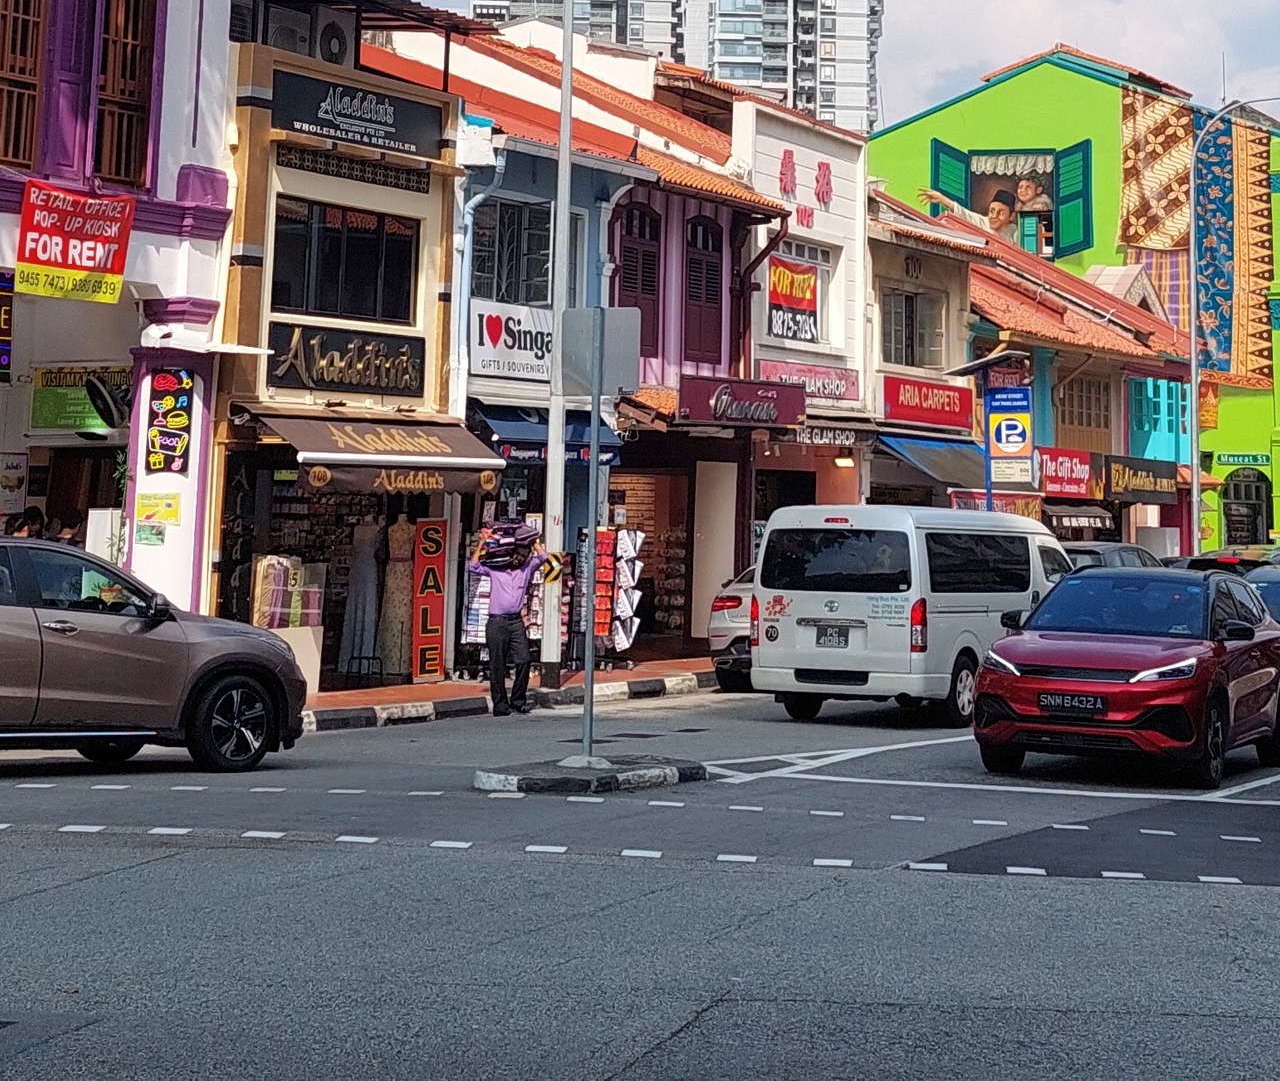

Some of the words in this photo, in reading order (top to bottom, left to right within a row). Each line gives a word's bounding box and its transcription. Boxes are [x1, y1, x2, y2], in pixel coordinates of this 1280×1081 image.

[318, 85, 395, 124] Aladdin's
[293, 121, 361, 141] WHOLESALER
[362, 134, 370, 143] &
[371, 137, 417, 153] RETAILER
[30, 187, 74, 211] RETAIL
[84, 199, 124, 217] OFFICE
[64, 215, 82, 232] UP
[83, 219, 121, 237] KIOSK
[25, 231, 62, 263] FOR
[68, 239, 118, 269] RENT
[19, 270, 40, 288] 9455
[771, 265, 792, 295] FOR
[477, 314, 485, 346] I
[272, 327, 420, 390] Aladdin's
[481, 359, 501, 370] GIFTS
[42, 373, 64, 387] VISIT
[824, 379, 846, 395] SHOP
[899, 384, 920, 407] ARIA
[921, 387, 960, 412] CARPETS
[158, 435, 179, 447] FOOD
[325, 423, 452, 454] Aladdin's
[796, 428, 811, 443] THE
[813, 429, 834, 444] GLAM
[835, 430, 855, 445] SHOP
[1042, 455, 1056, 477] The
[1057, 456, 1071, 480] Gift
[1072, 457, 1089, 483] Shop
[1220, 455, 1252, 463] Muscat
[1257, 455, 1267, 463] St
[373, 470, 444, 490] Aladdin's
[417, 526, 444, 677] SALE
[768, 628, 777, 638] 70
[827, 628, 839, 636] PC
